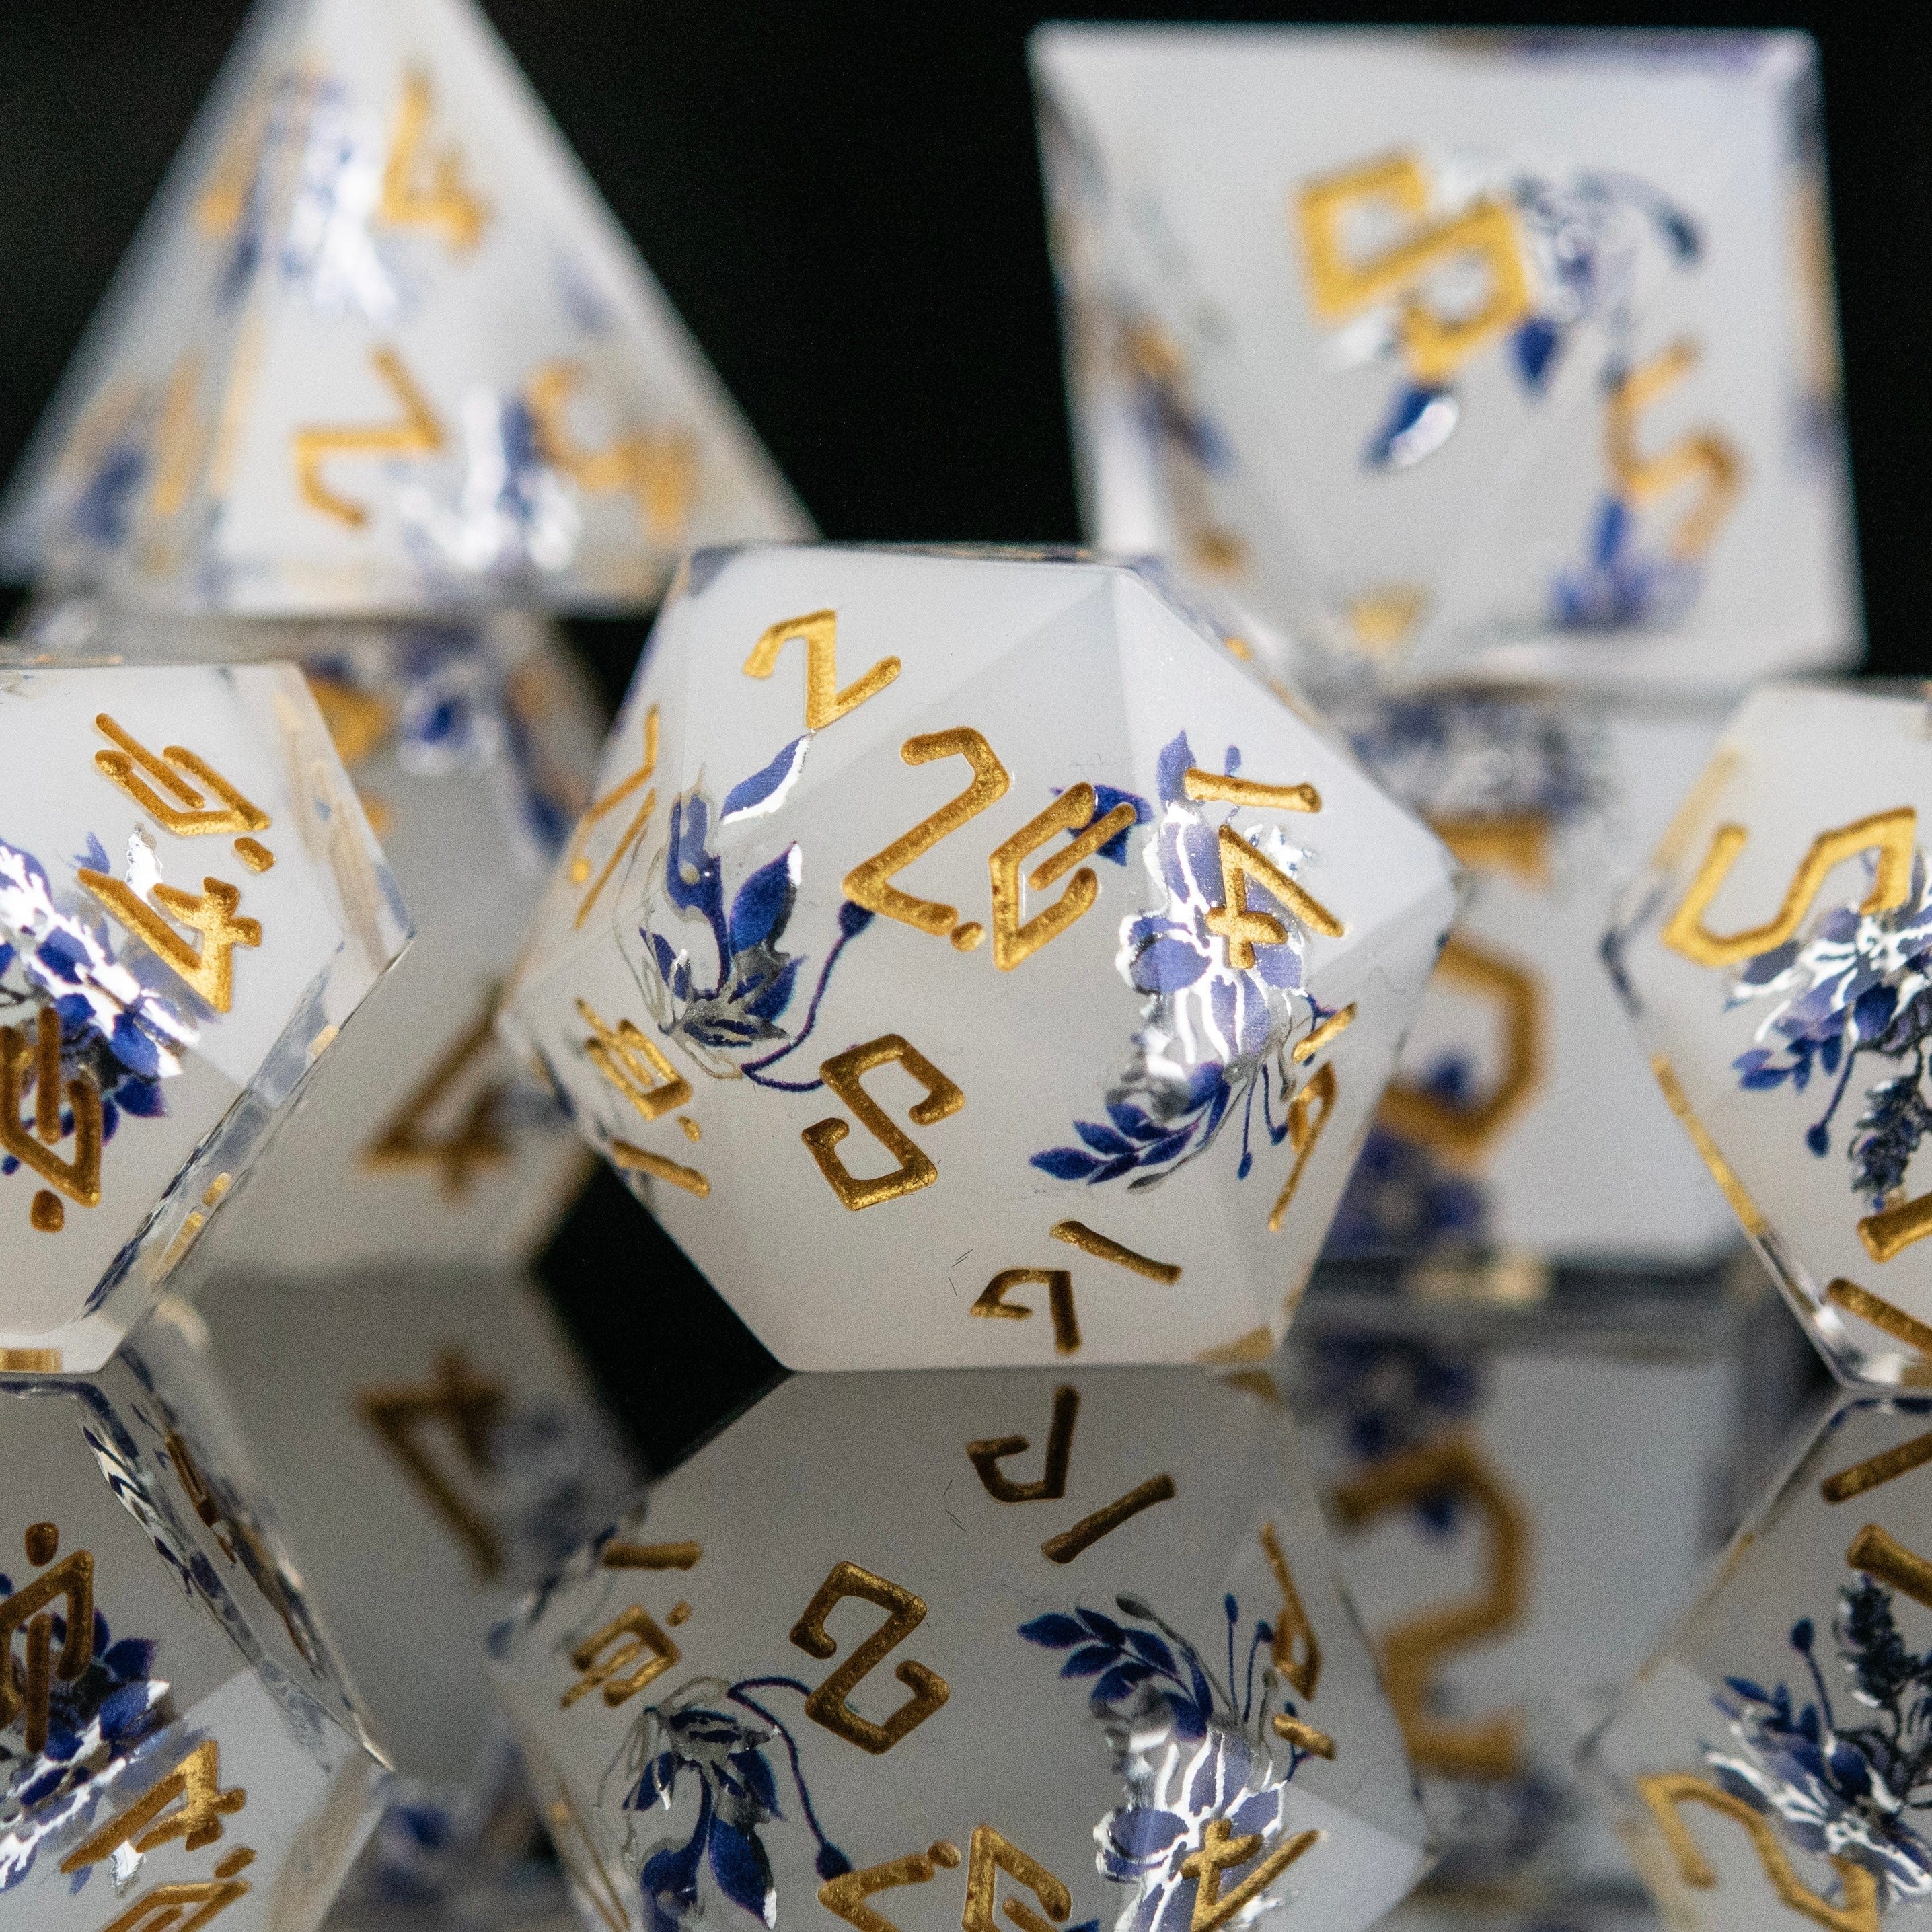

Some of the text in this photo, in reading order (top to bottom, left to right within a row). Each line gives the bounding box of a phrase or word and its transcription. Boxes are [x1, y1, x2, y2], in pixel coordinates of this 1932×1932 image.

[743, 608, 903, 731] 2
[1184, 767, 1345, 969] 14
[1661, 806, 1917, 967] 5
